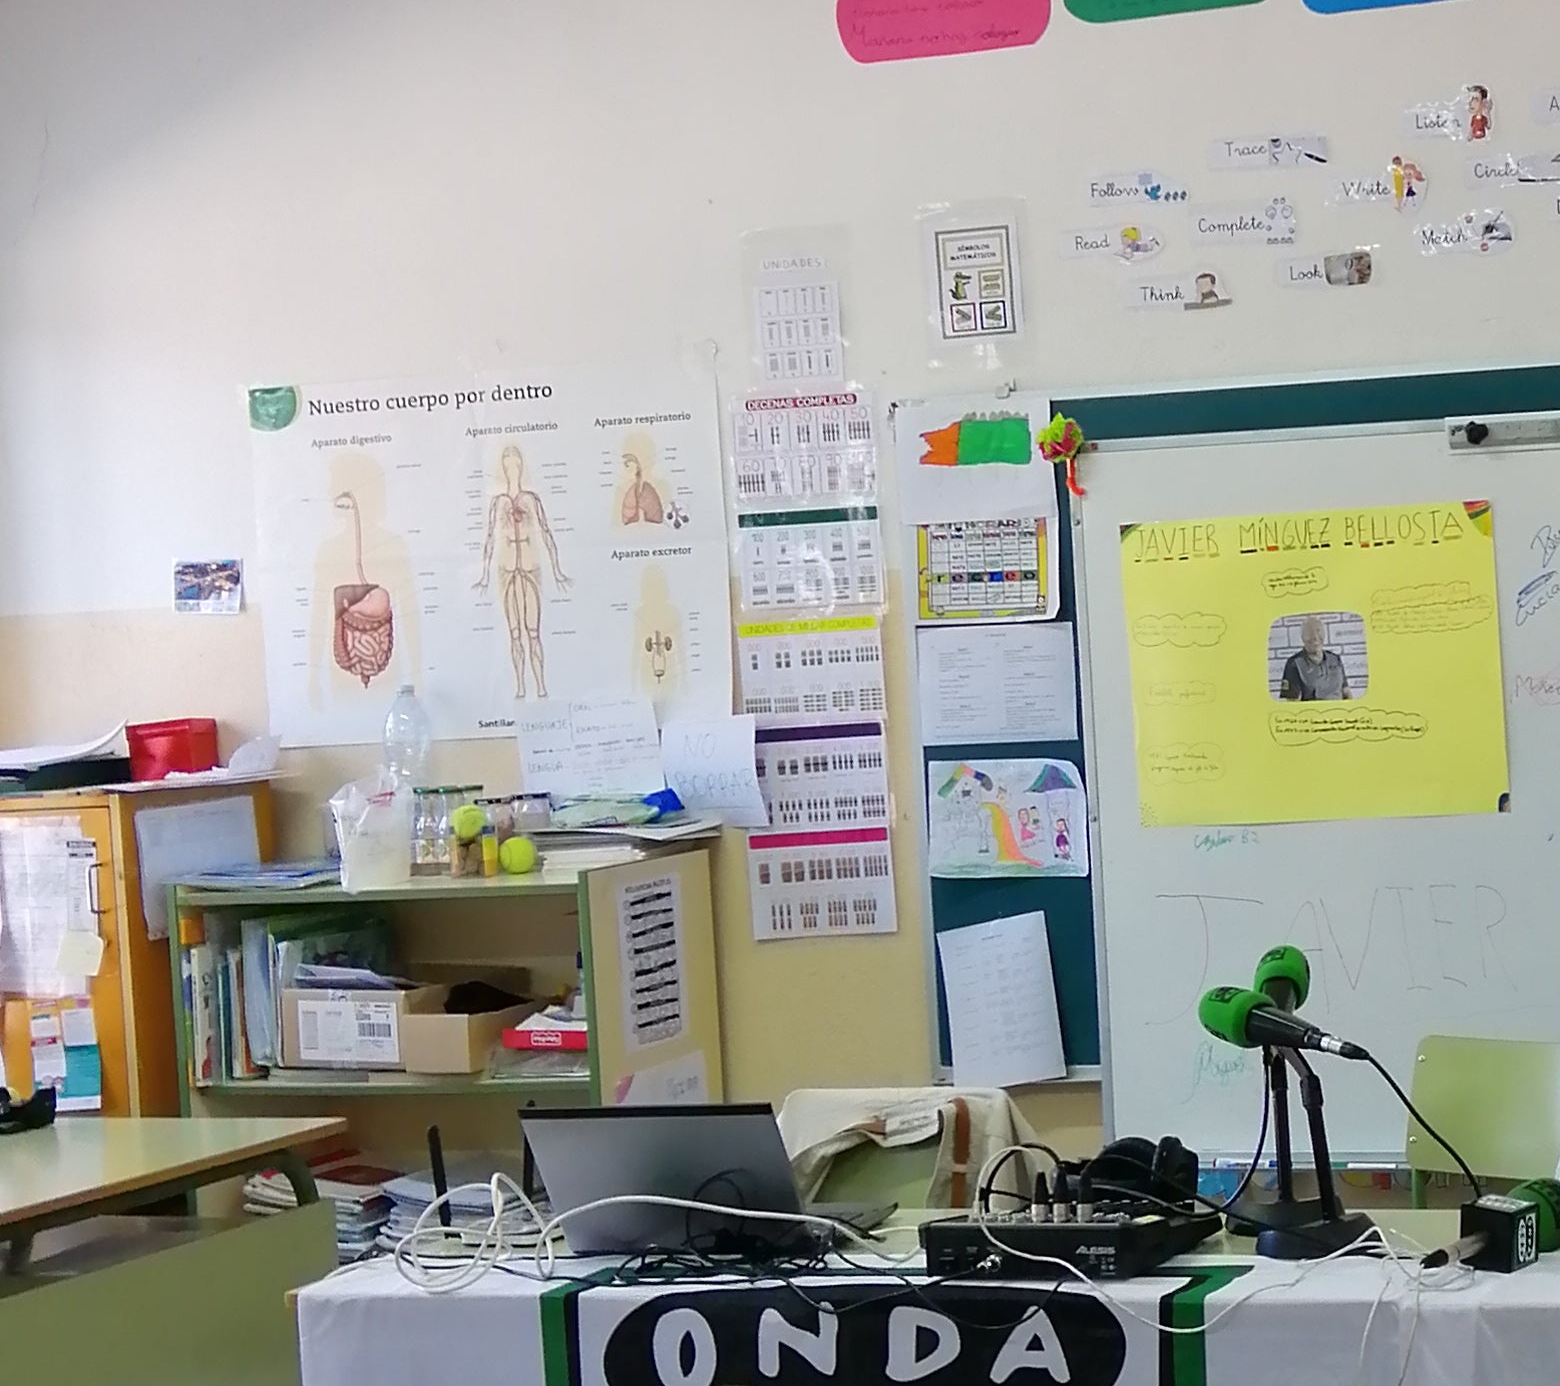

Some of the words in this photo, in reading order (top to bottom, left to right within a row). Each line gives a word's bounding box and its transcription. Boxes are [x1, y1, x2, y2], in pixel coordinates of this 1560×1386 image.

[1224, 141, 1266, 156] Trace
[1090, 181, 1139, 197] Follow
[1342, 180, 1391, 196] Write
[1198, 217, 1264, 237] Complete
[1074, 235, 1111, 250] Read
[1290, 266, 1323, 281] Look
[1140, 286, 1185, 302] Think
[308, 396, 381, 416] Nuestro
[385, 391, 450, 413] cuerpo
[454, 388, 487, 409] por
[490, 383, 554, 402] dentro
[748, 398, 794, 410] DECENAS
[796, 394, 855, 408] COMPLETAS
[593, 415, 633, 429] Aparato
[634, 411, 692, 427] respiratorio
[465, 425, 503, 438] Aparato
[504, 420, 559, 435] circulatorio
[311, 436, 349, 449] Aparato
[349, 432, 393, 447] digestivo
[1134, 523, 1219, 558] JAVIER
[1239, 517, 1331, 549] MÍNGUEZ
[1344, 510, 1464, 542] BELLOSTA
[611, 548, 650, 561] Aparato
[651, 545, 692, 558] excretor
[684, 731, 718, 760] NO
